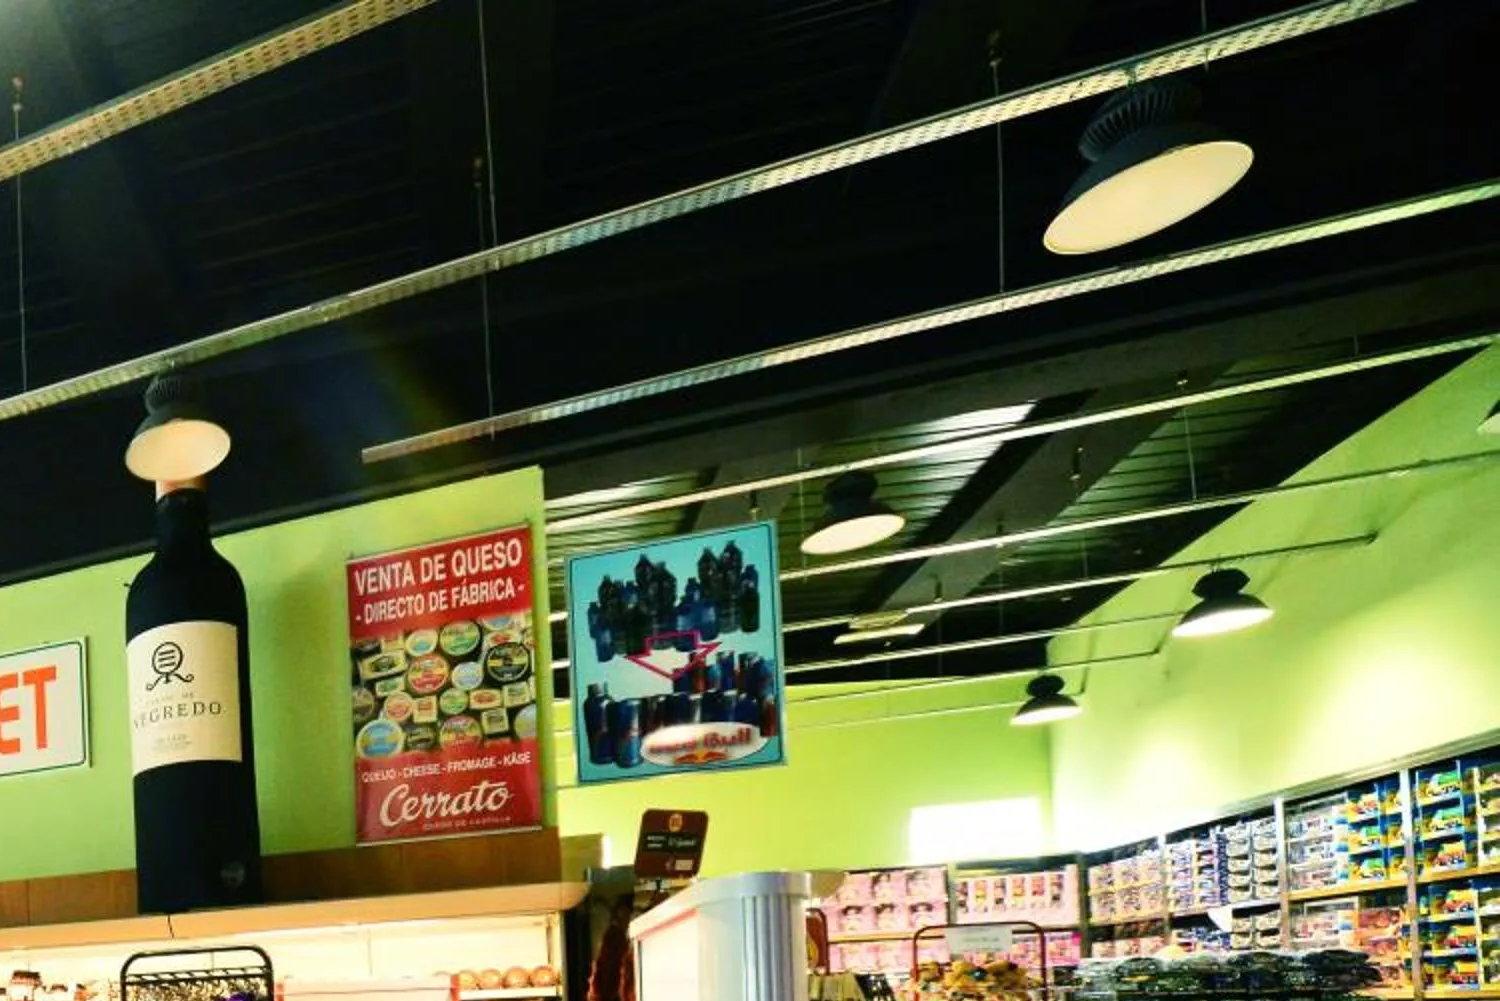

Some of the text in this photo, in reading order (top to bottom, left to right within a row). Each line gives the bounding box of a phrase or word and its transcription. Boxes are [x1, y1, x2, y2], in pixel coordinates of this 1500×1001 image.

[355, 538, 523, 596] VENTA DE QUESO
[365, 593, 425, 624] DIRECTO
[429, 590, 449, 612] DE
[451, 577, 515, 608] FÁBRICA
[403, 763, 441, 779] CHEESE
[448, 756, 498, 773] FROMAGE
[379, 780, 514, 827] Cerrato
